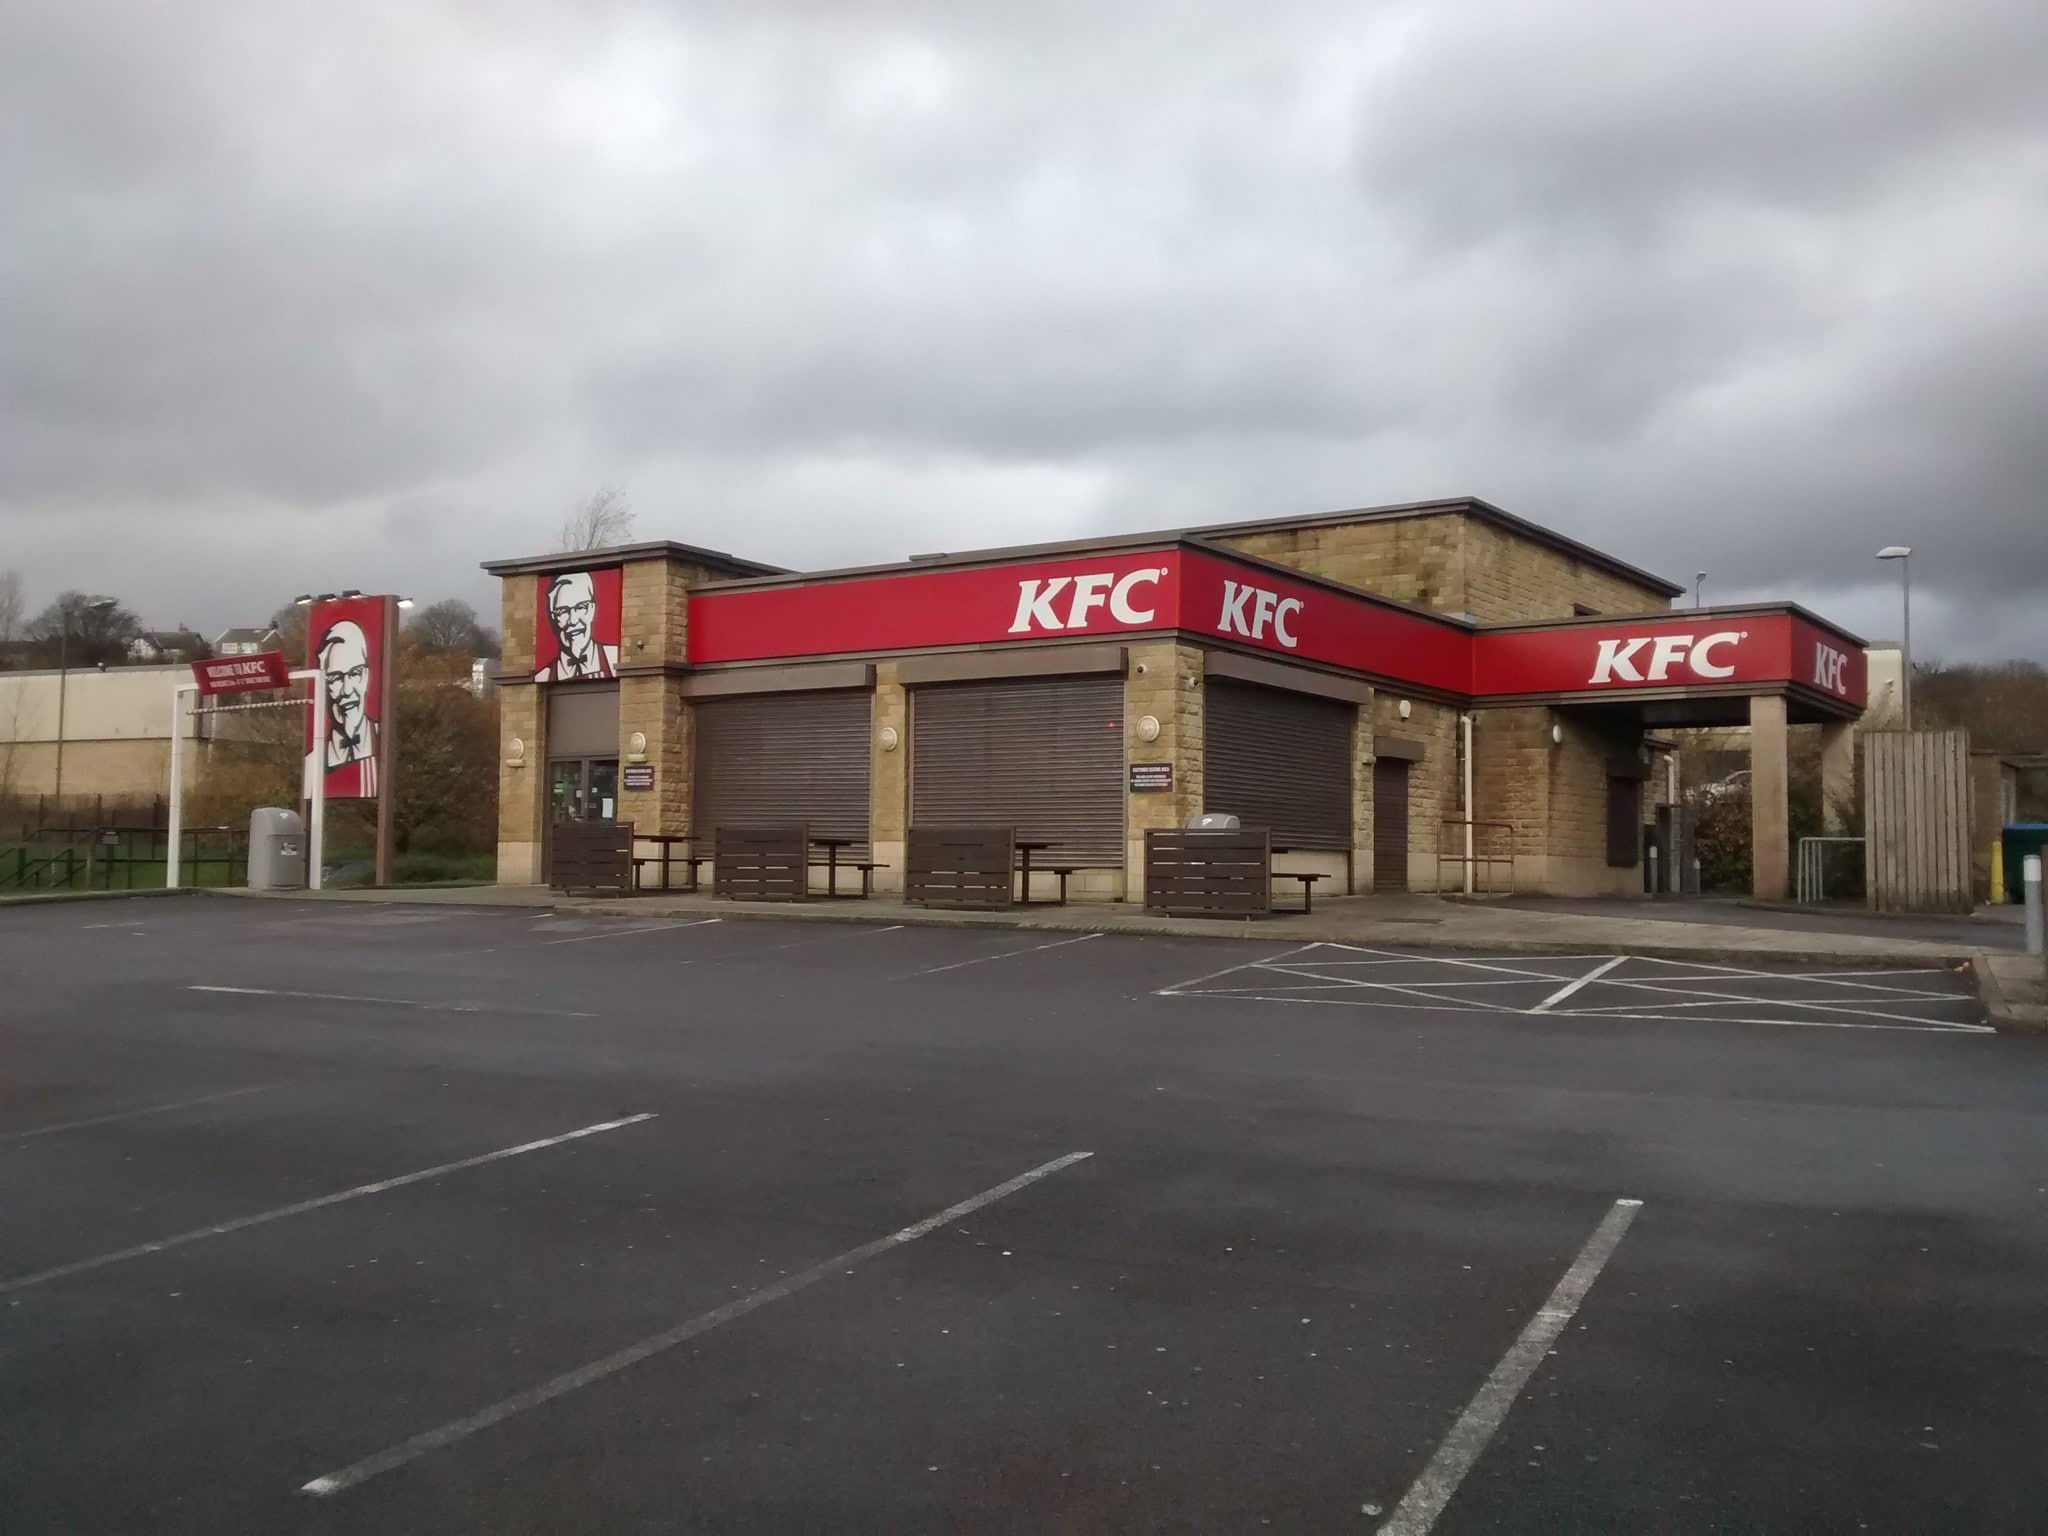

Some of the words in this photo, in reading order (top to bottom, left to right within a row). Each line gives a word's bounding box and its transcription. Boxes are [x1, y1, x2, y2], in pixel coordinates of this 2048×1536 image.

[1008, 568, 1161, 633] KFC
[1217, 579, 1301, 648] KFC
[243, 661, 265, 674] KFC
[1588, 631, 1741, 684] KFC
[1813, 641, 1847, 696] KFC
